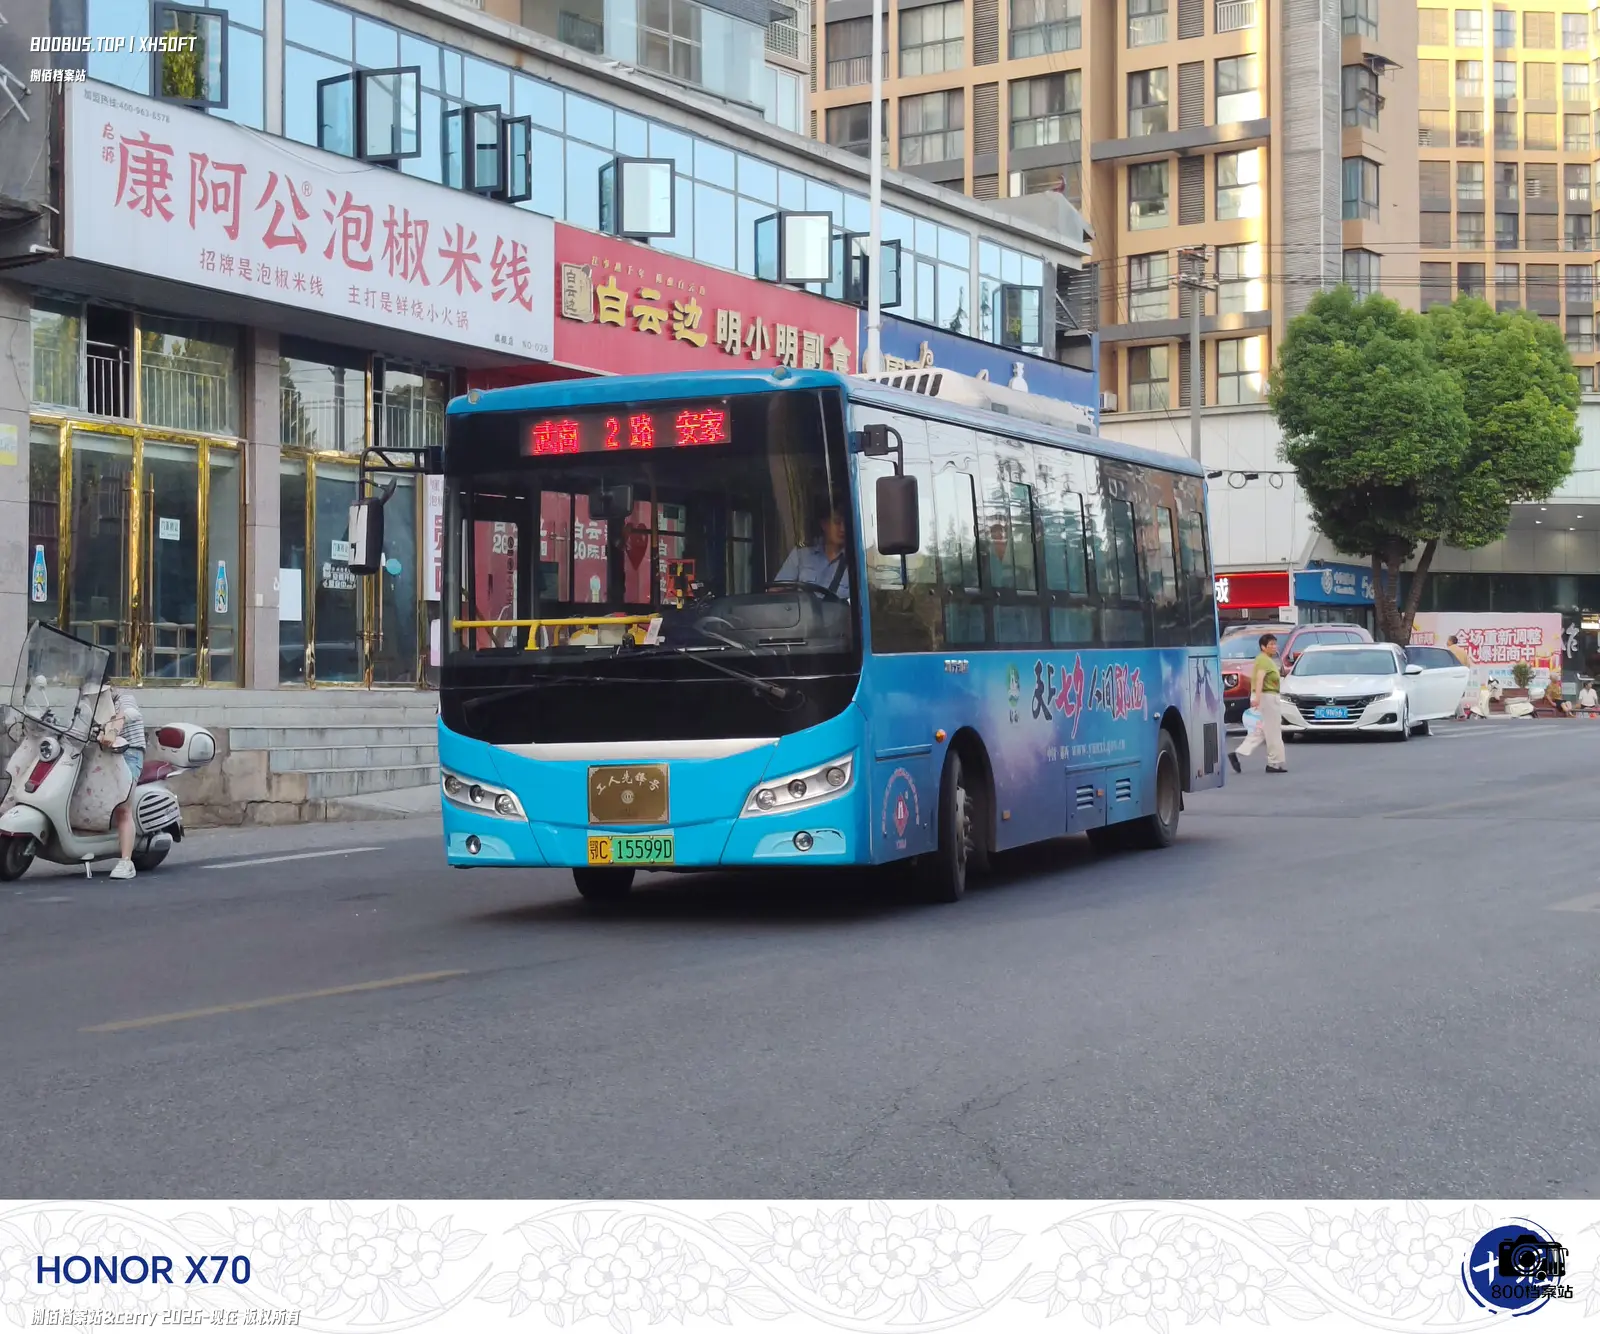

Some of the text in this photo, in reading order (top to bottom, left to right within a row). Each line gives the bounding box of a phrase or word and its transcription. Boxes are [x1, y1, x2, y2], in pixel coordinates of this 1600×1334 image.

[199, 248, 470, 331] 招牌是泡椒米线 主打是鲜烧小火锅
[596, 275, 708, 348] 白云边
[675, 407, 725, 445] 安家
[1456, 627, 1542, 647] 全场重新调整
